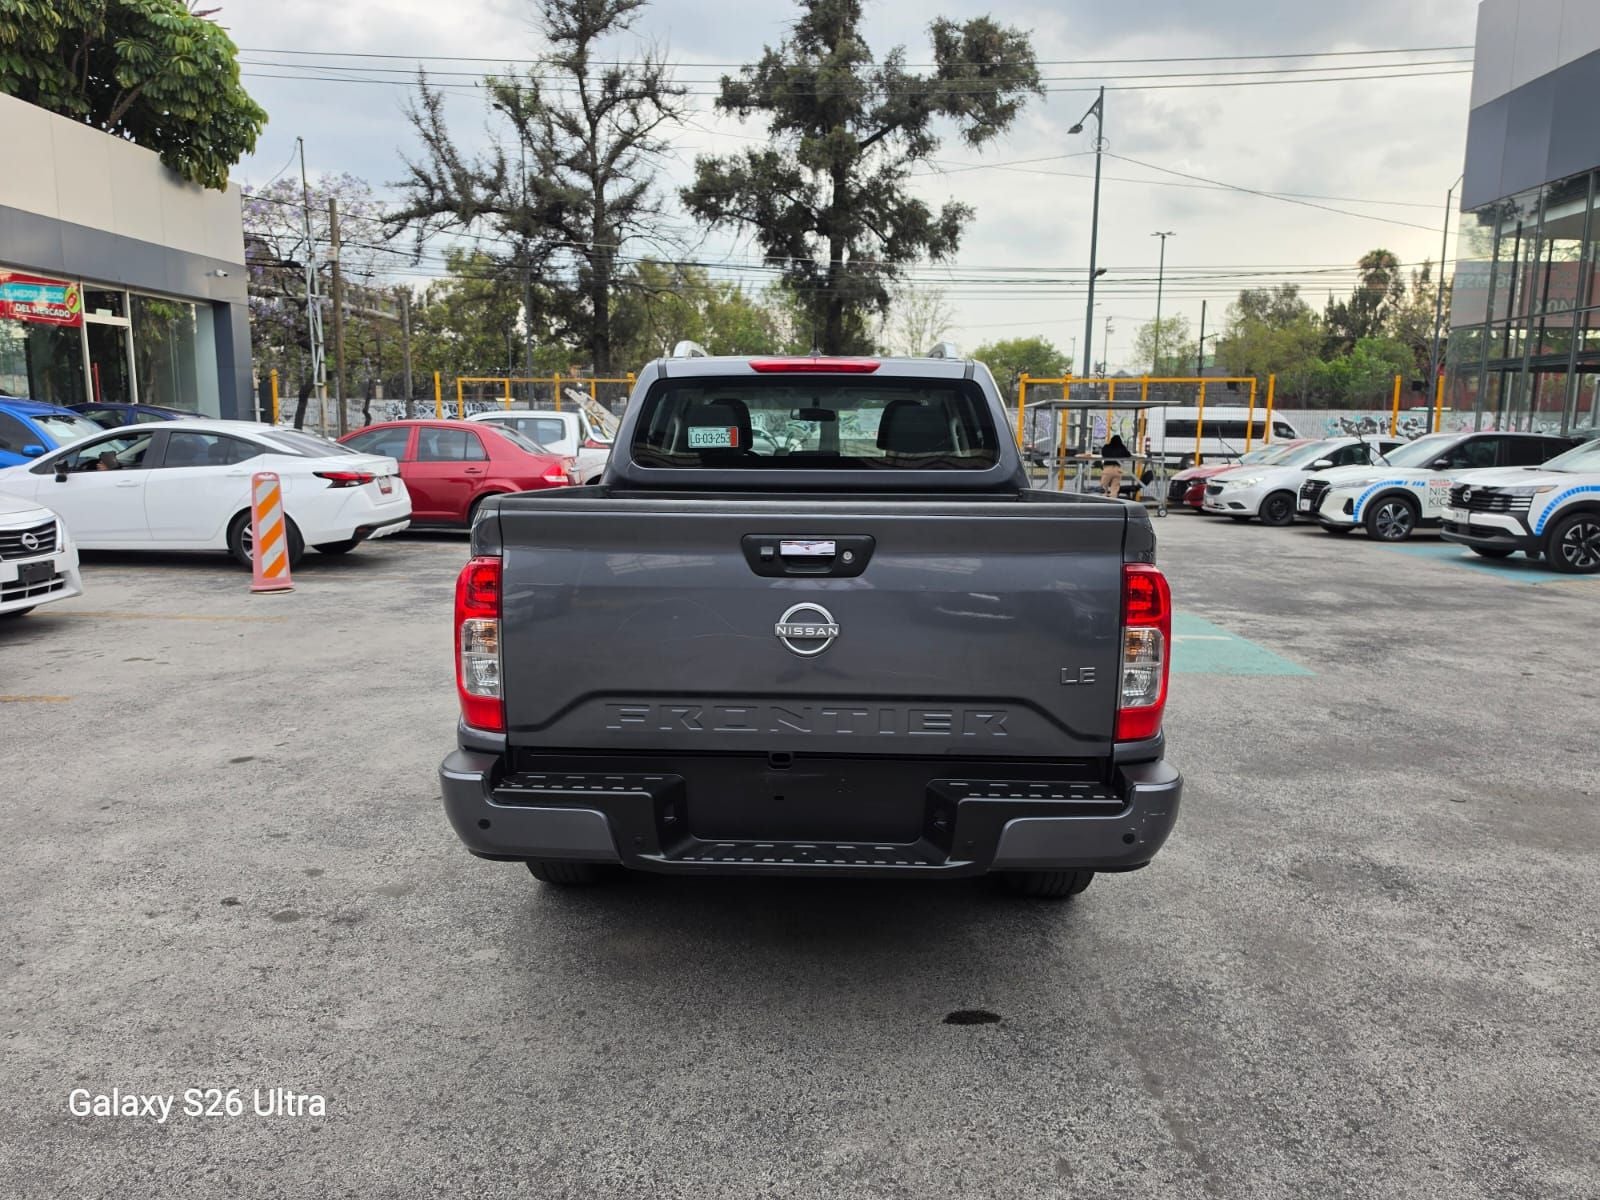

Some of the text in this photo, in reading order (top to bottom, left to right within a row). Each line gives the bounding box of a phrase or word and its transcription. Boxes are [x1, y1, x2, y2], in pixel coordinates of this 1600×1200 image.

[15, 303, 31, 313] DEL
[776, 626, 839, 636] NISSAN
[1061, 667, 1096, 684] LE
[604, 702, 1009, 737] FRONTIER
